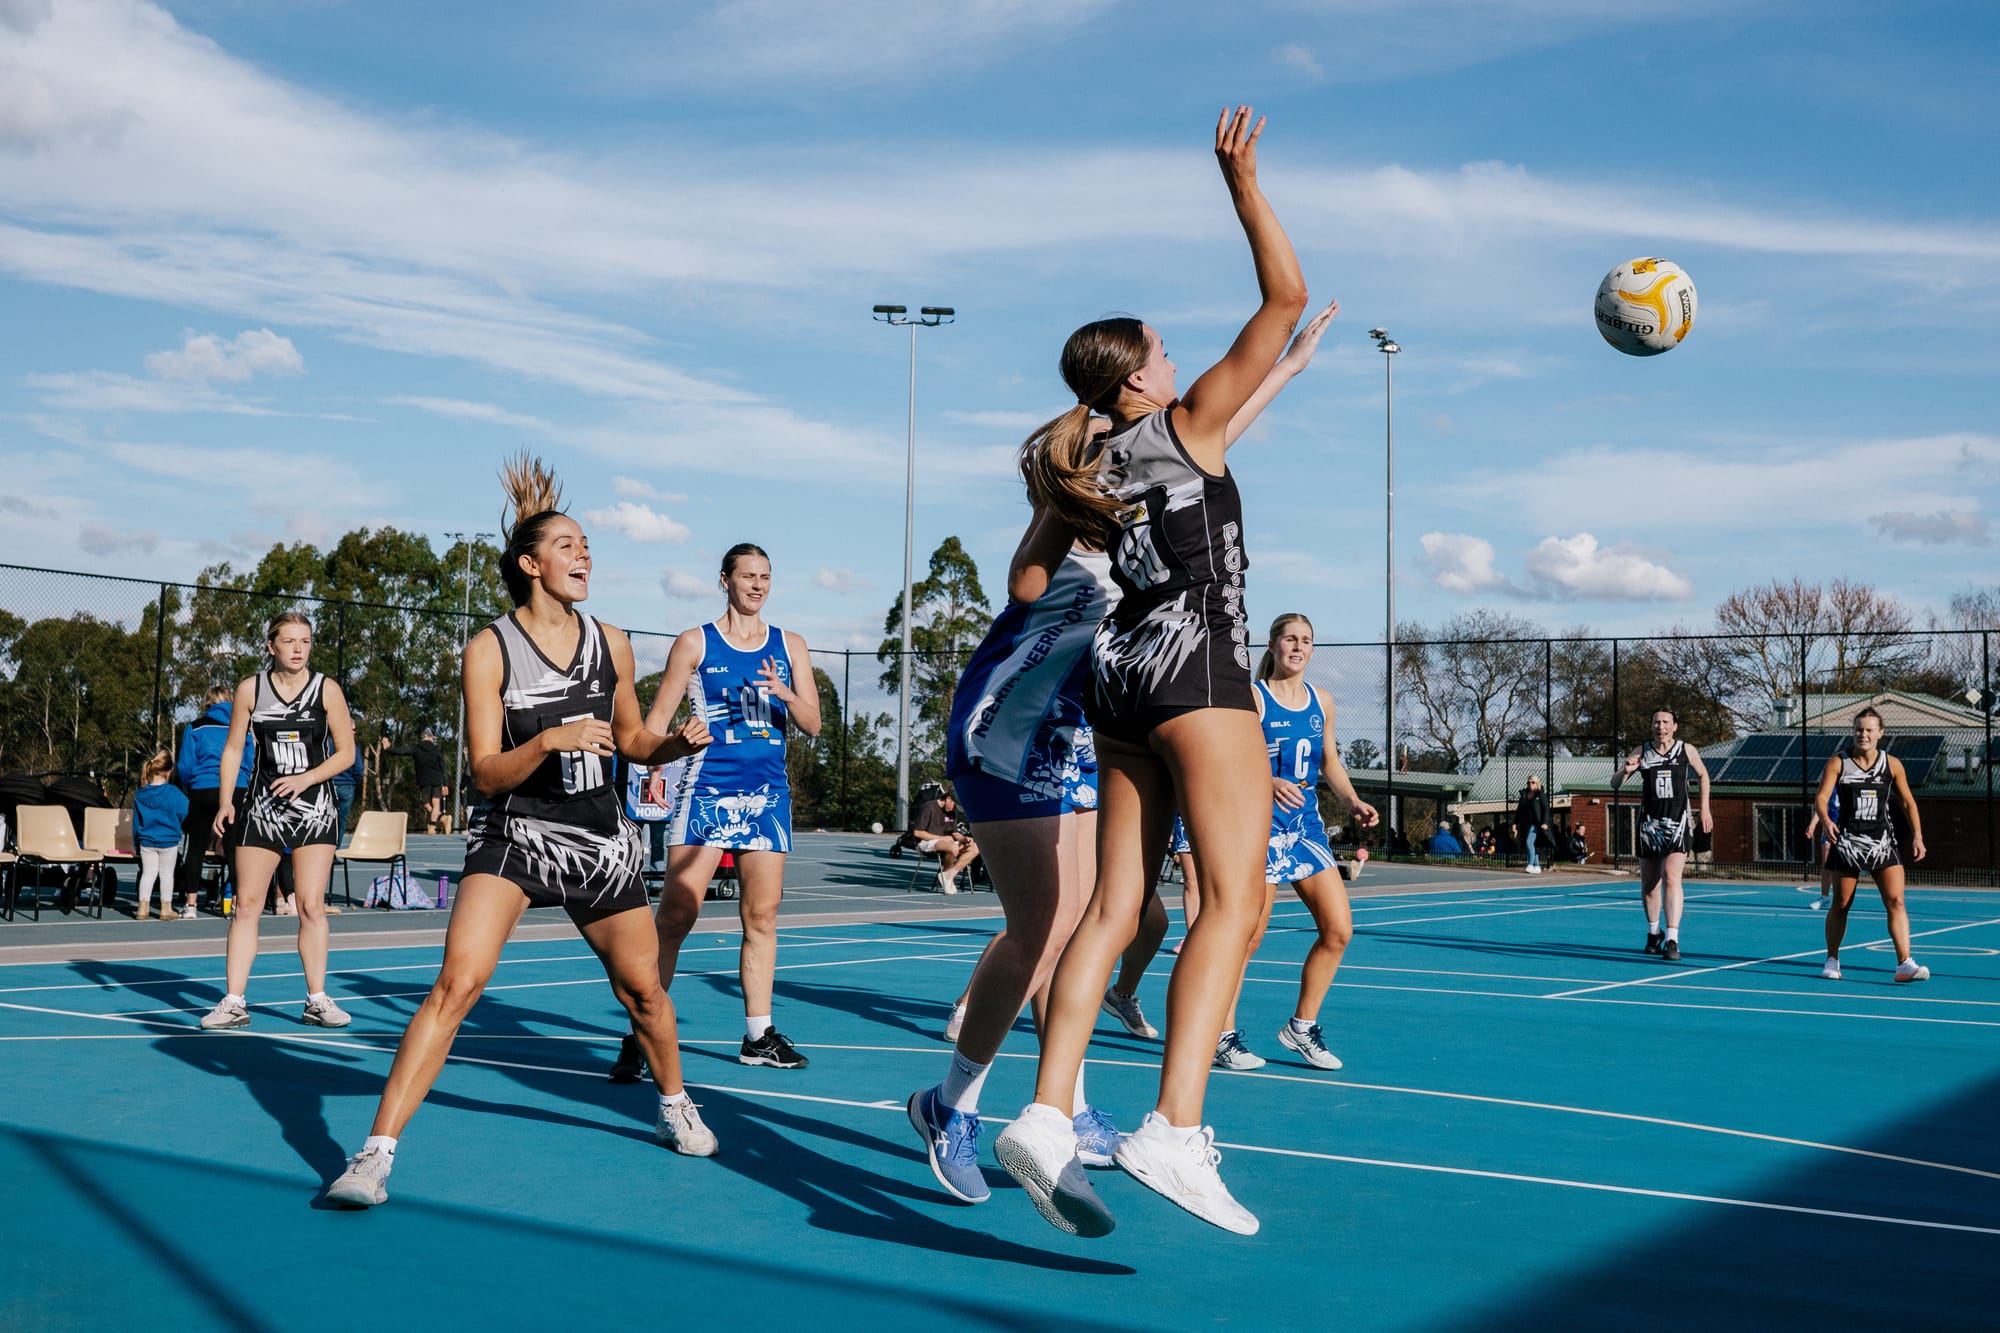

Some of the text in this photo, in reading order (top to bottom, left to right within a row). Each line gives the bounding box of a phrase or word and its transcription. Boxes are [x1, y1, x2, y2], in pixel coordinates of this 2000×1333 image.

[1597, 311, 1654, 335] GILBER
[741, 686, 774, 728] GA
[271, 741, 309, 775] WD
[1294, 738, 1312, 780] C
[1019, 792, 1049, 804] BL
[1655, 777, 1674, 799] GA
[635, 806, 669, 818] HOME
